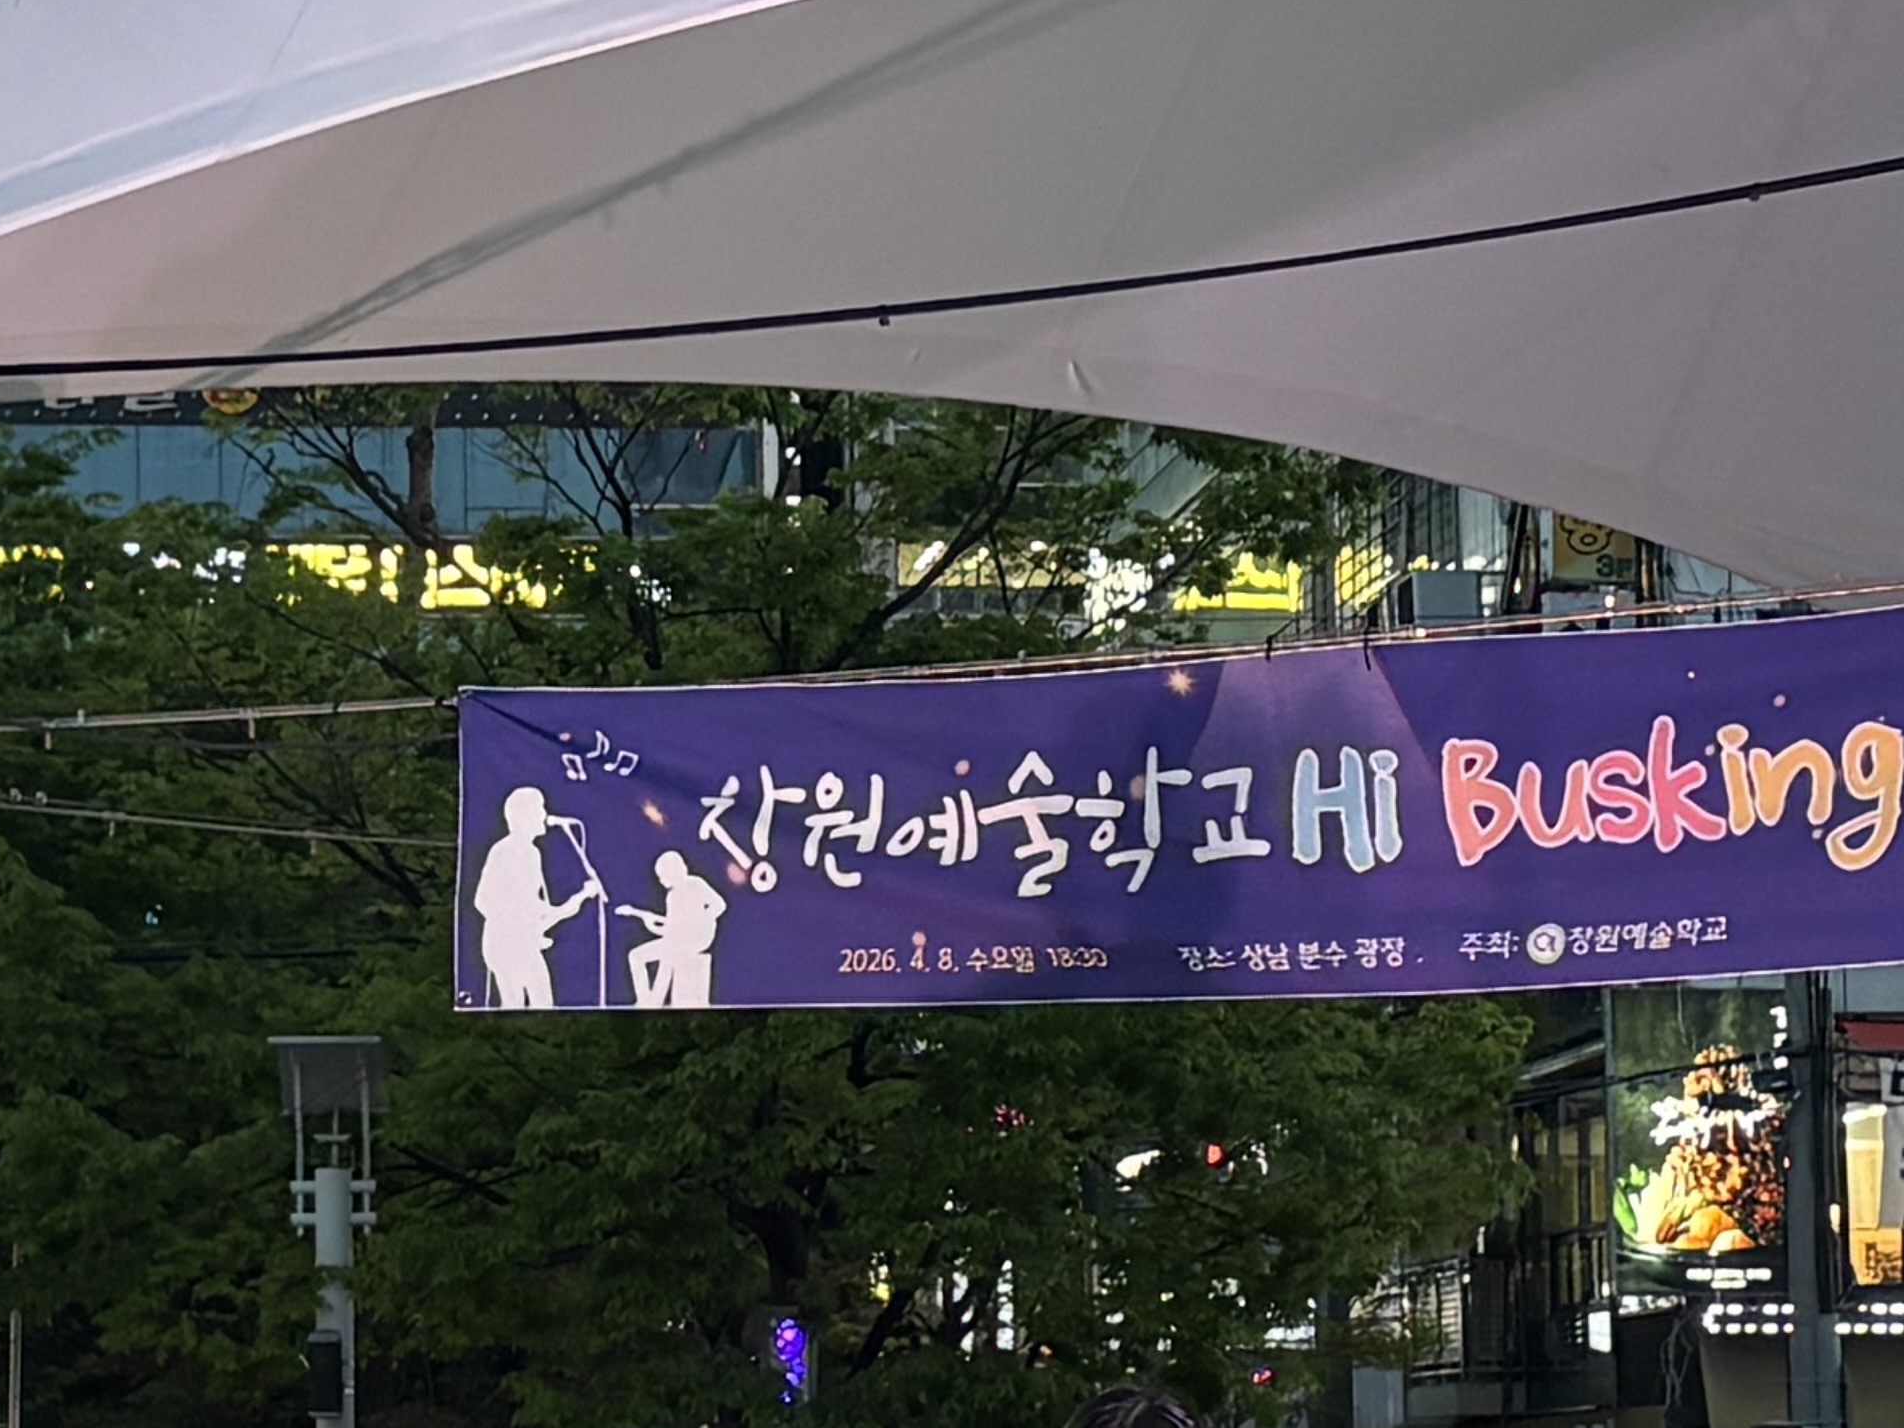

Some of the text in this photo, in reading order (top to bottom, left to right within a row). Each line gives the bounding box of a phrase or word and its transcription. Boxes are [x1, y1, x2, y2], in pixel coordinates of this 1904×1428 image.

[699, 746, 1271, 897] 창원예술학교
[1291, 745, 1403, 873] Hi
[838, 948, 902, 973] 2026.
[937, 946, 960, 973] 8.
[966, 945, 1035, 973] 수요일
